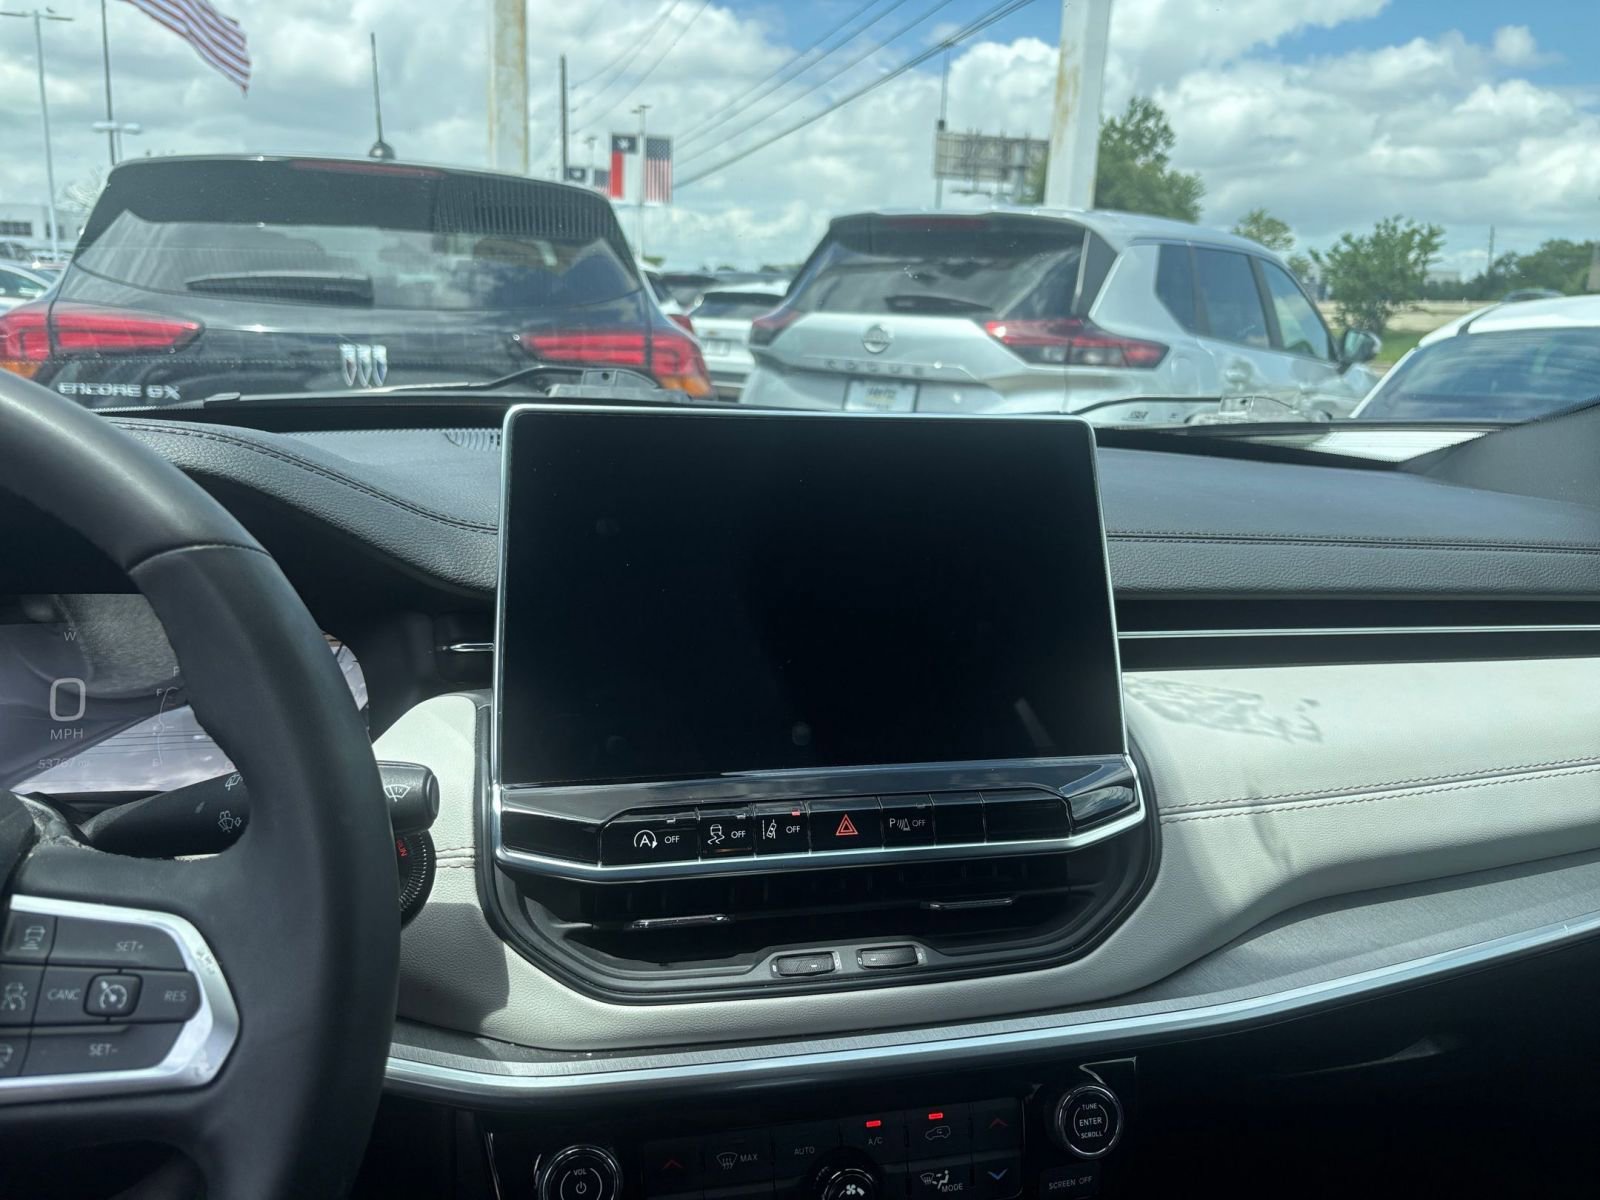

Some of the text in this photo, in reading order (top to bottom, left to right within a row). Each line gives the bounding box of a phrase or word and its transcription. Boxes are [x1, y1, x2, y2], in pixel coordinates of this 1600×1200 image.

[57, 381, 180, 400] ENCORE GX
[63, 630, 77, 642] W
[49, 728, 84, 741] MPH
[912, 818, 927, 828] OFF
[730, 829, 747, 840] OFF
[785, 824, 801, 834] OFF
[664, 834, 681, 845] OFF
[47, 988, 82, 1001] CANC
[164, 989, 188, 1002] RES
[1081, 1102, 1098, 1111] TUNE
[1078, 1116, 1103, 1127] ENTER
[868, 1135, 884, 1146] A/C
[1080, 1130, 1104, 1140] SCROLL
[793, 1145, 816, 1155] AUTO
[739, 1152, 759, 1163] MAX
[573, 1167, 588, 1176] VOL
[941, 1182, 964, 1193] MODE
[1048, 1175, 1093, 1191] SCREEN OFF
